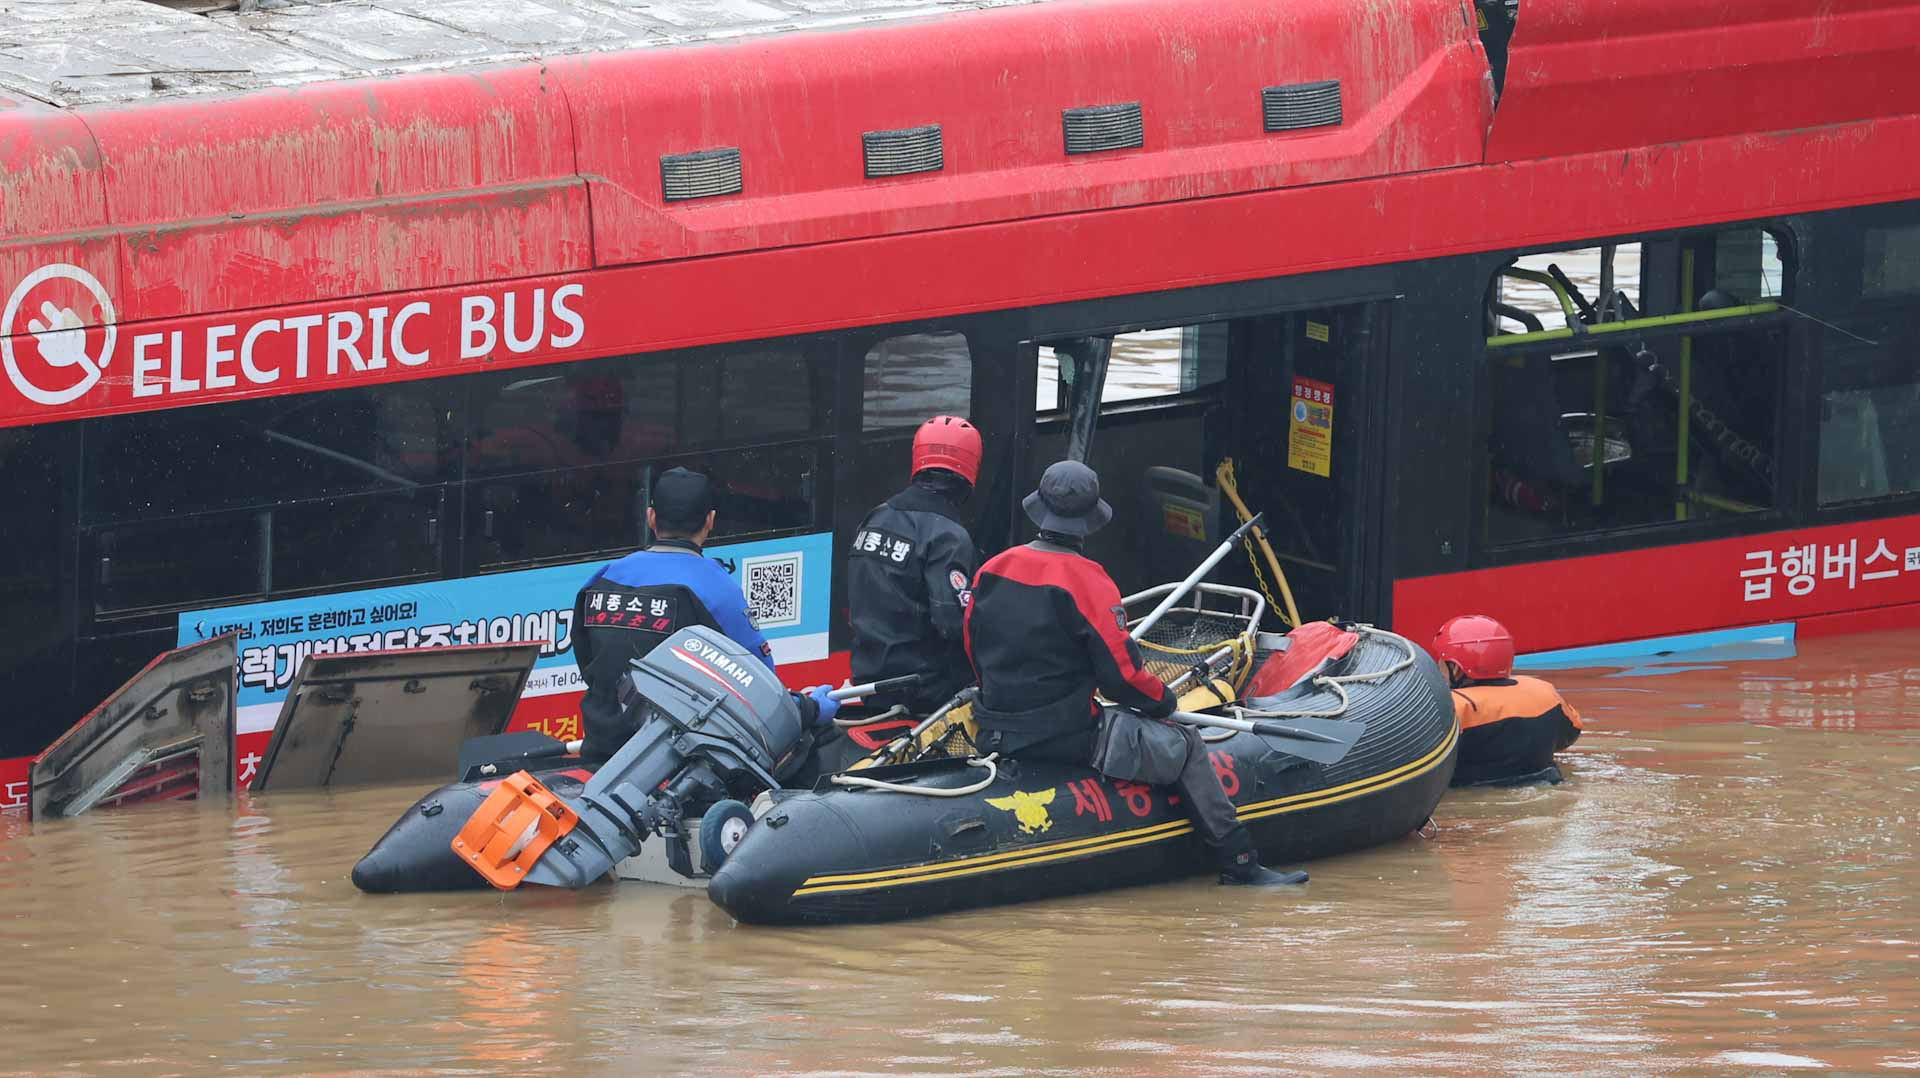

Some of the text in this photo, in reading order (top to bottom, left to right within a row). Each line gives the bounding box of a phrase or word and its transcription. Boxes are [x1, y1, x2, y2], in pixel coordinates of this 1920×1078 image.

[131, 284, 585, 399] ELECTRIC BUS
[1740, 538, 1900, 602] 급행버스
[261, 616, 304, 637] 저희도
[308, 607, 366, 631] 훈련하고
[370, 601, 418, 623] 싶어요!
[551, 672, 567, 687] Tel
[700, 645, 754, 687] YAMAHA
